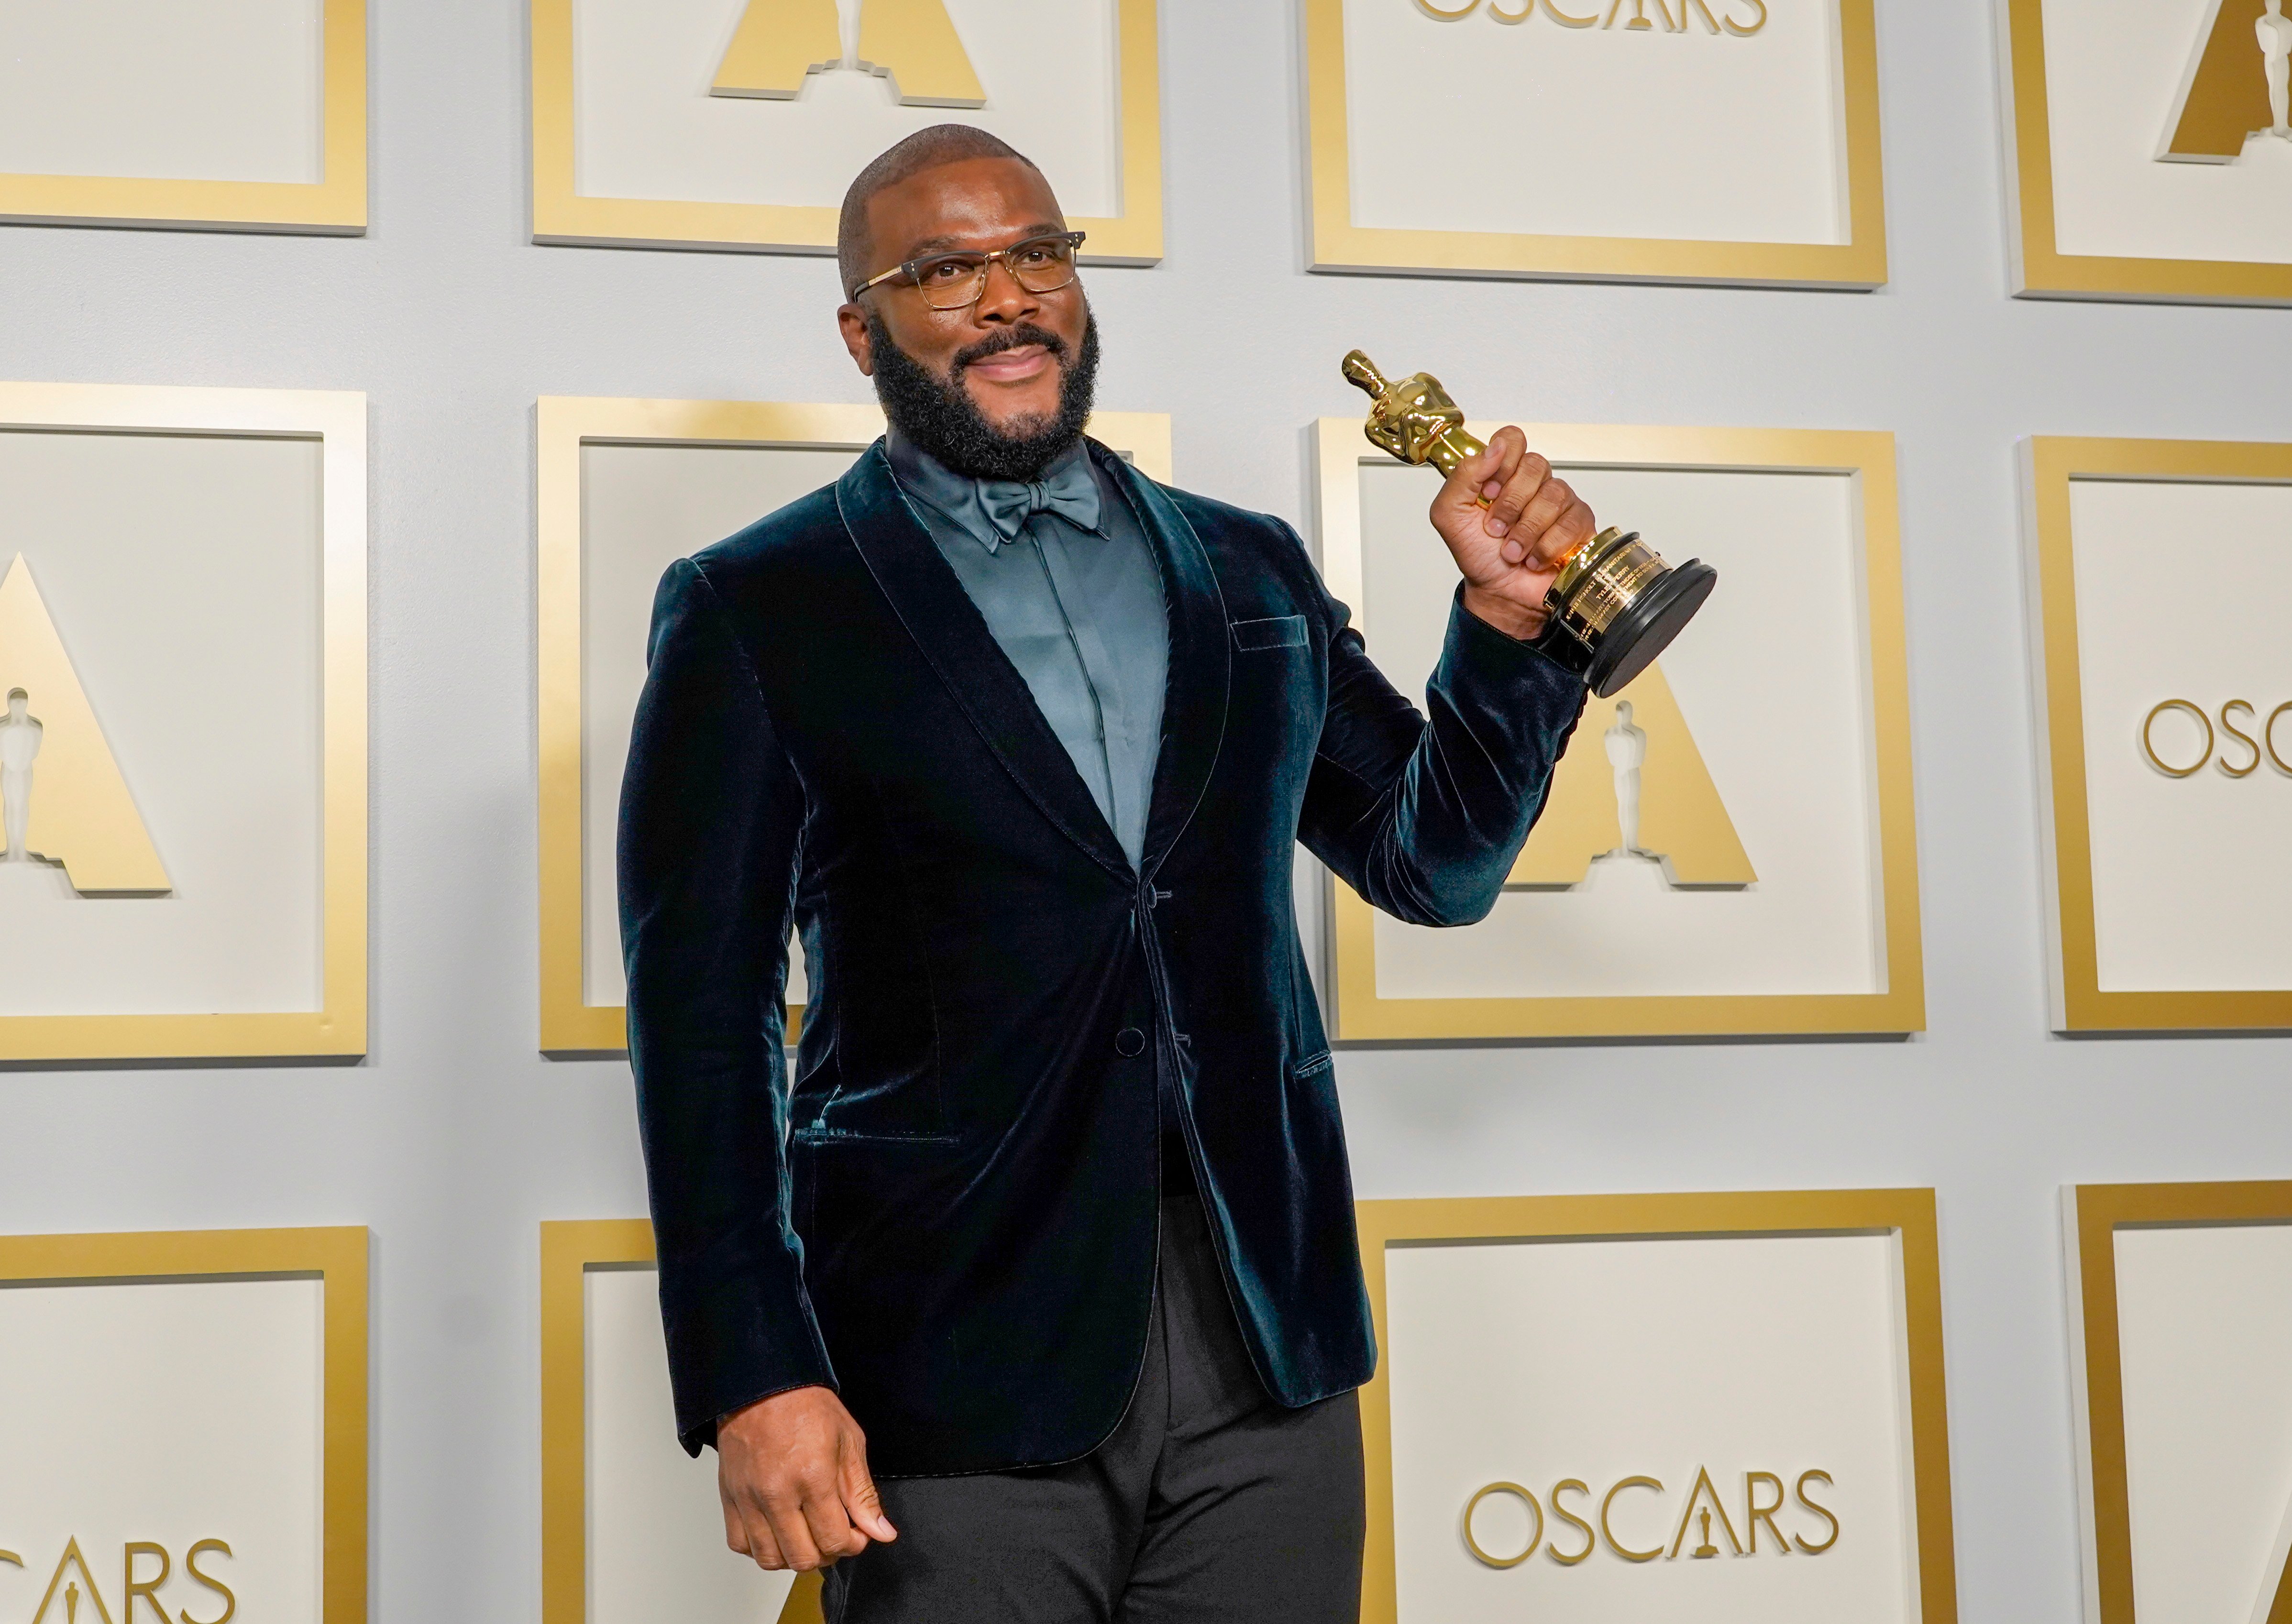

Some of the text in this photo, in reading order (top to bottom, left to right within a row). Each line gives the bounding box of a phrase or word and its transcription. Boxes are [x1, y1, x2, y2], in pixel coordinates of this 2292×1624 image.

[1611, 564, 1631, 583] PERRY
[1463, 1465, 1839, 1566] OSCARS
[0, 1535, 235, 1624] ARS
